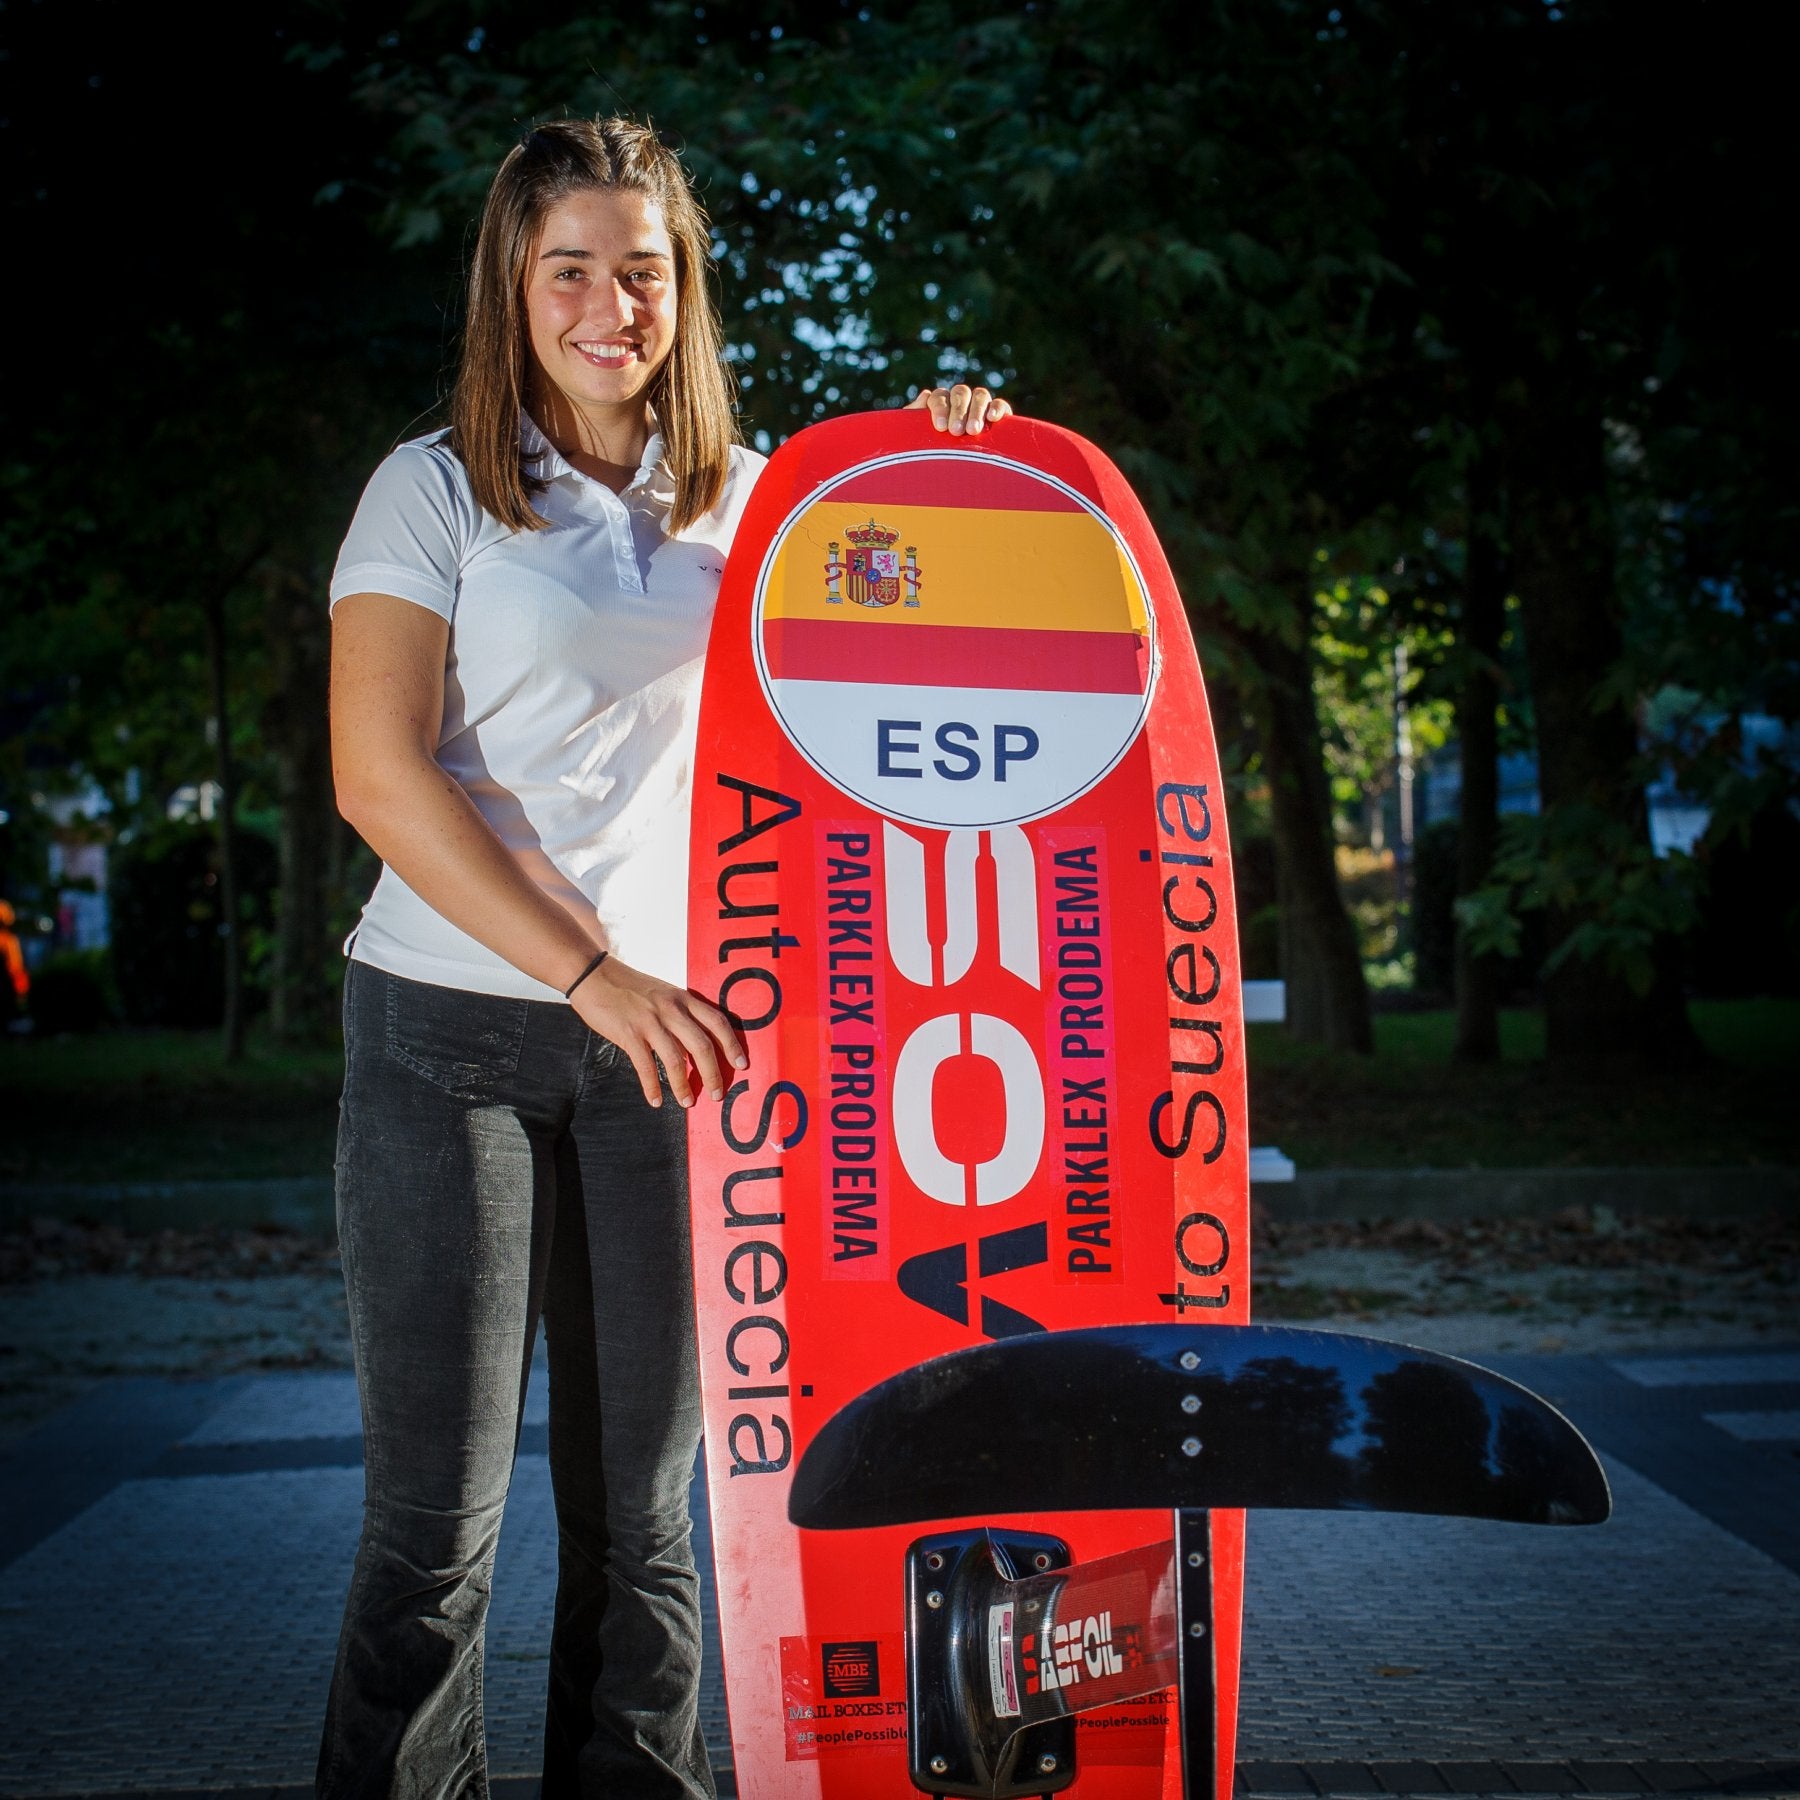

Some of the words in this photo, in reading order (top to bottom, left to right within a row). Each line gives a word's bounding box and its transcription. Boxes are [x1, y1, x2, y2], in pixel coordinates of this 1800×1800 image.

[876, 719, 1040, 783] ESP
[716, 772, 802, 1031] Auto
[826, 833, 874, 1025] PARKLEX
[1054, 844, 1106, 1059] PRODEMA
[1139, 782, 1228, 1165] Suecia
[829, 1044, 878, 1262] PRODEMA
[1060, 1077, 1112, 1274] PARKLEX
[720, 1078, 813, 1479] Suecia
[788, 1704, 831, 1721] MAIL
[834, 1702, 884, 1718] BOXES
[886, 1701, 907, 1716] ET
[833, 1663, 869, 1677] MBE
